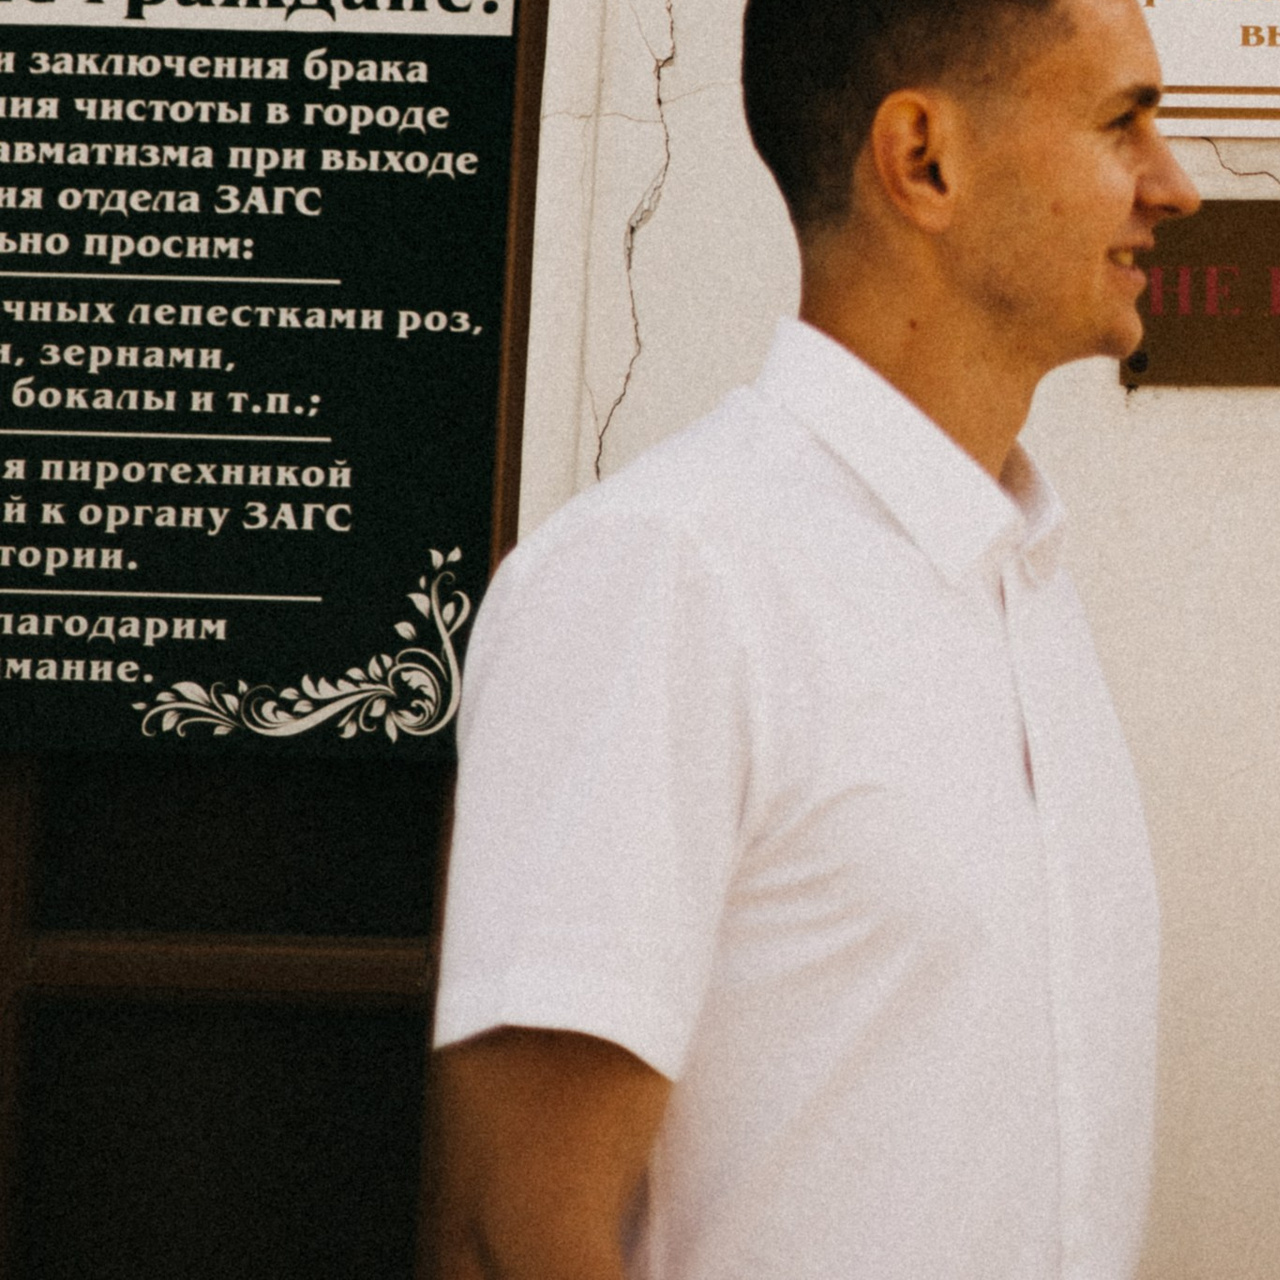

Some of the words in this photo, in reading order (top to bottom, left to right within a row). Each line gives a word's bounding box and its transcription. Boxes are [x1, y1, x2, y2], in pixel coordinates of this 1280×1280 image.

[30, 53, 288, 79] заключения
[304, 48, 427, 89] брака
[0, 97, 58, 118] ия
[75, 99, 250, 123] чистоты
[267, 103, 289, 123] в
[305, 104, 448, 134] городе
[229, 147, 305, 177] при
[322, 150, 477, 177] выходе
[58, 189, 199, 214] отдела
[216, 185, 320, 215] ЗАГС
[85, 234, 253, 264] просим:
[1147, 266, 1240, 315] НЕ
[4, 301, 113, 323] чных
[129, 304, 382, 329] лепестками
[398, 311, 481, 338] роз,
[41, 345, 234, 373] зернами,
[12, 377, 175, 410] бокалы
[192, 392, 213, 411] и
[229, 392, 320, 416] т.п.;
[4, 460, 25, 479] я
[42, 460, 350, 489] пиротехникой
[3, 494, 26, 524] й
[42, 504, 64, 524] к
[79, 505, 229, 535] органу
[244, 502, 350, 531] ЗАГС
[0, 658, 154, 683] мание.
